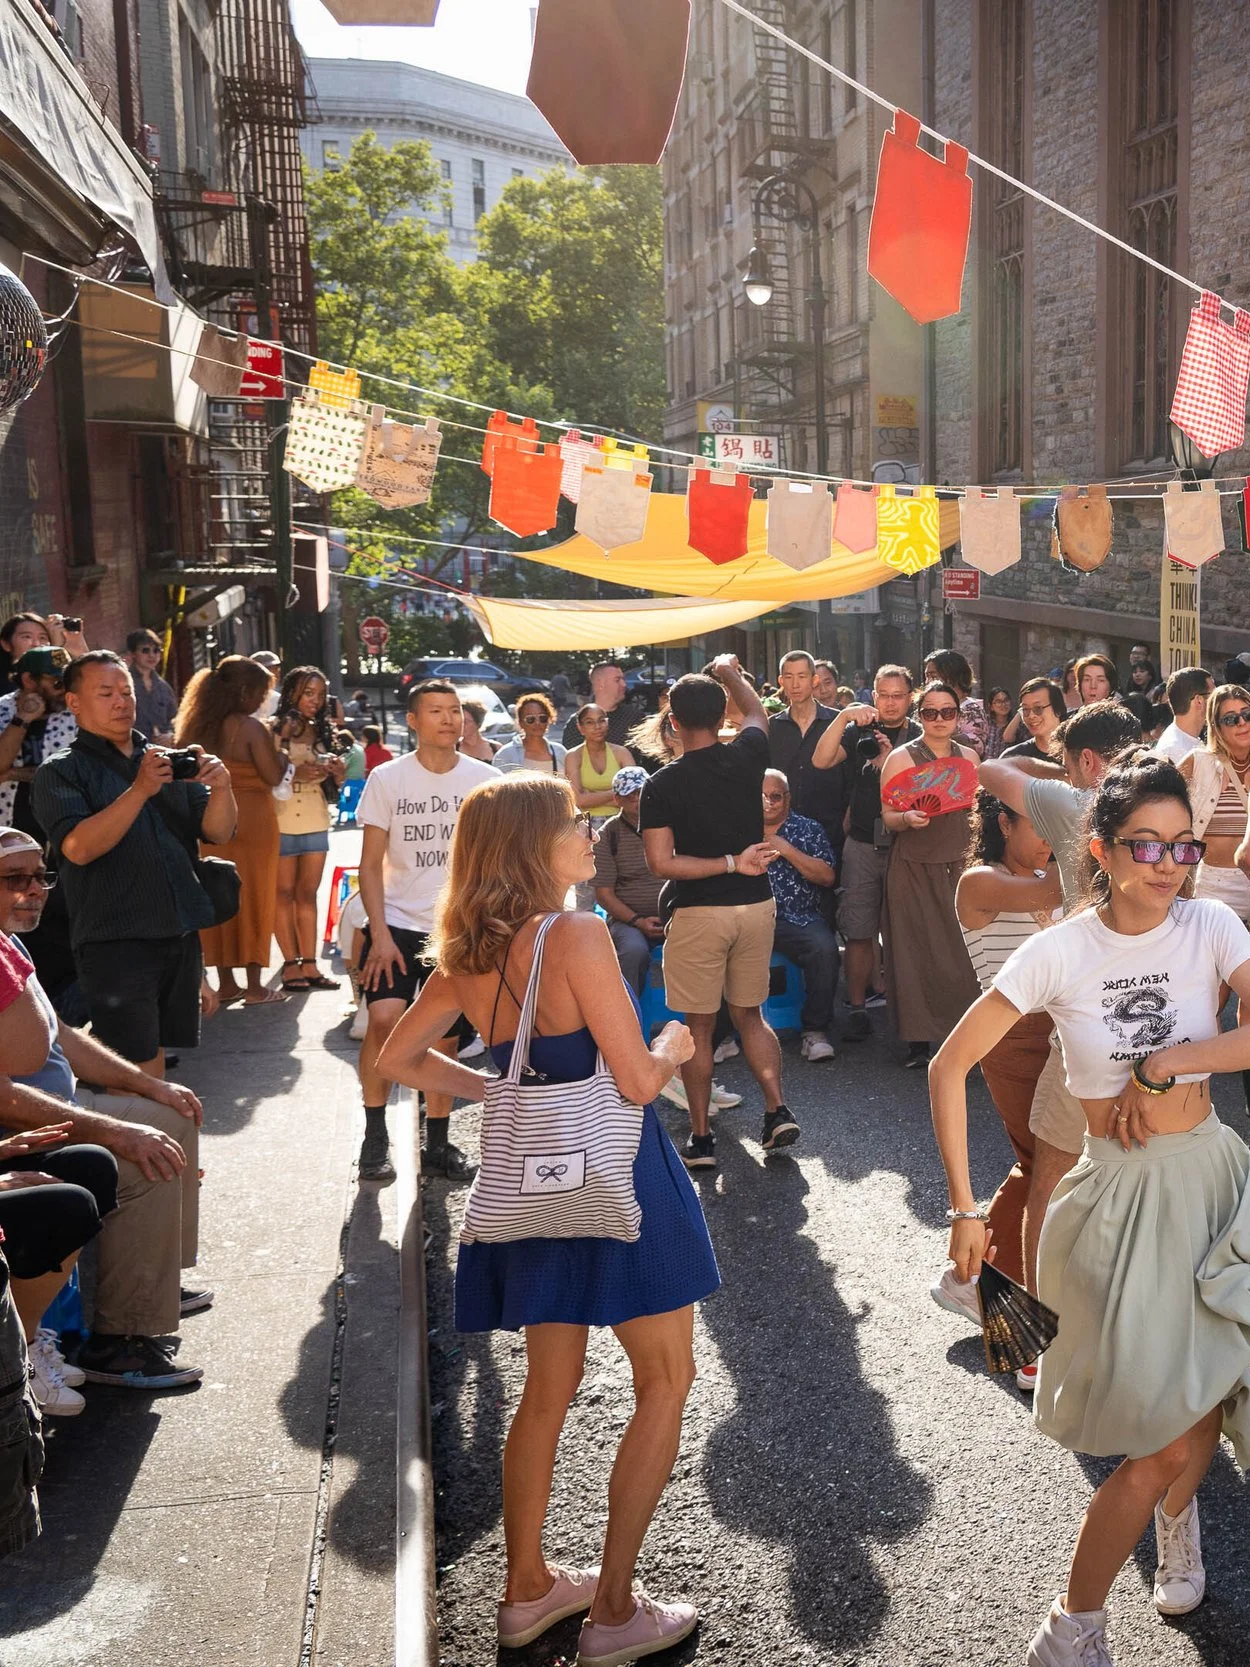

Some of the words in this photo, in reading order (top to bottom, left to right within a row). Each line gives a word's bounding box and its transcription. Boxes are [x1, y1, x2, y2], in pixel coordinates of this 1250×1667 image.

[721, 437, 774, 460] 鍋貼
[1169, 582, 1198, 612] THINK!
[1169, 614, 1197, 645] CHINA
[1169, 647, 1197, 677] TOWN
[396, 798, 427, 816] How
[431, 795, 449, 813] Do
[403, 823, 437, 842] END
[415, 850, 449, 868] NOW
